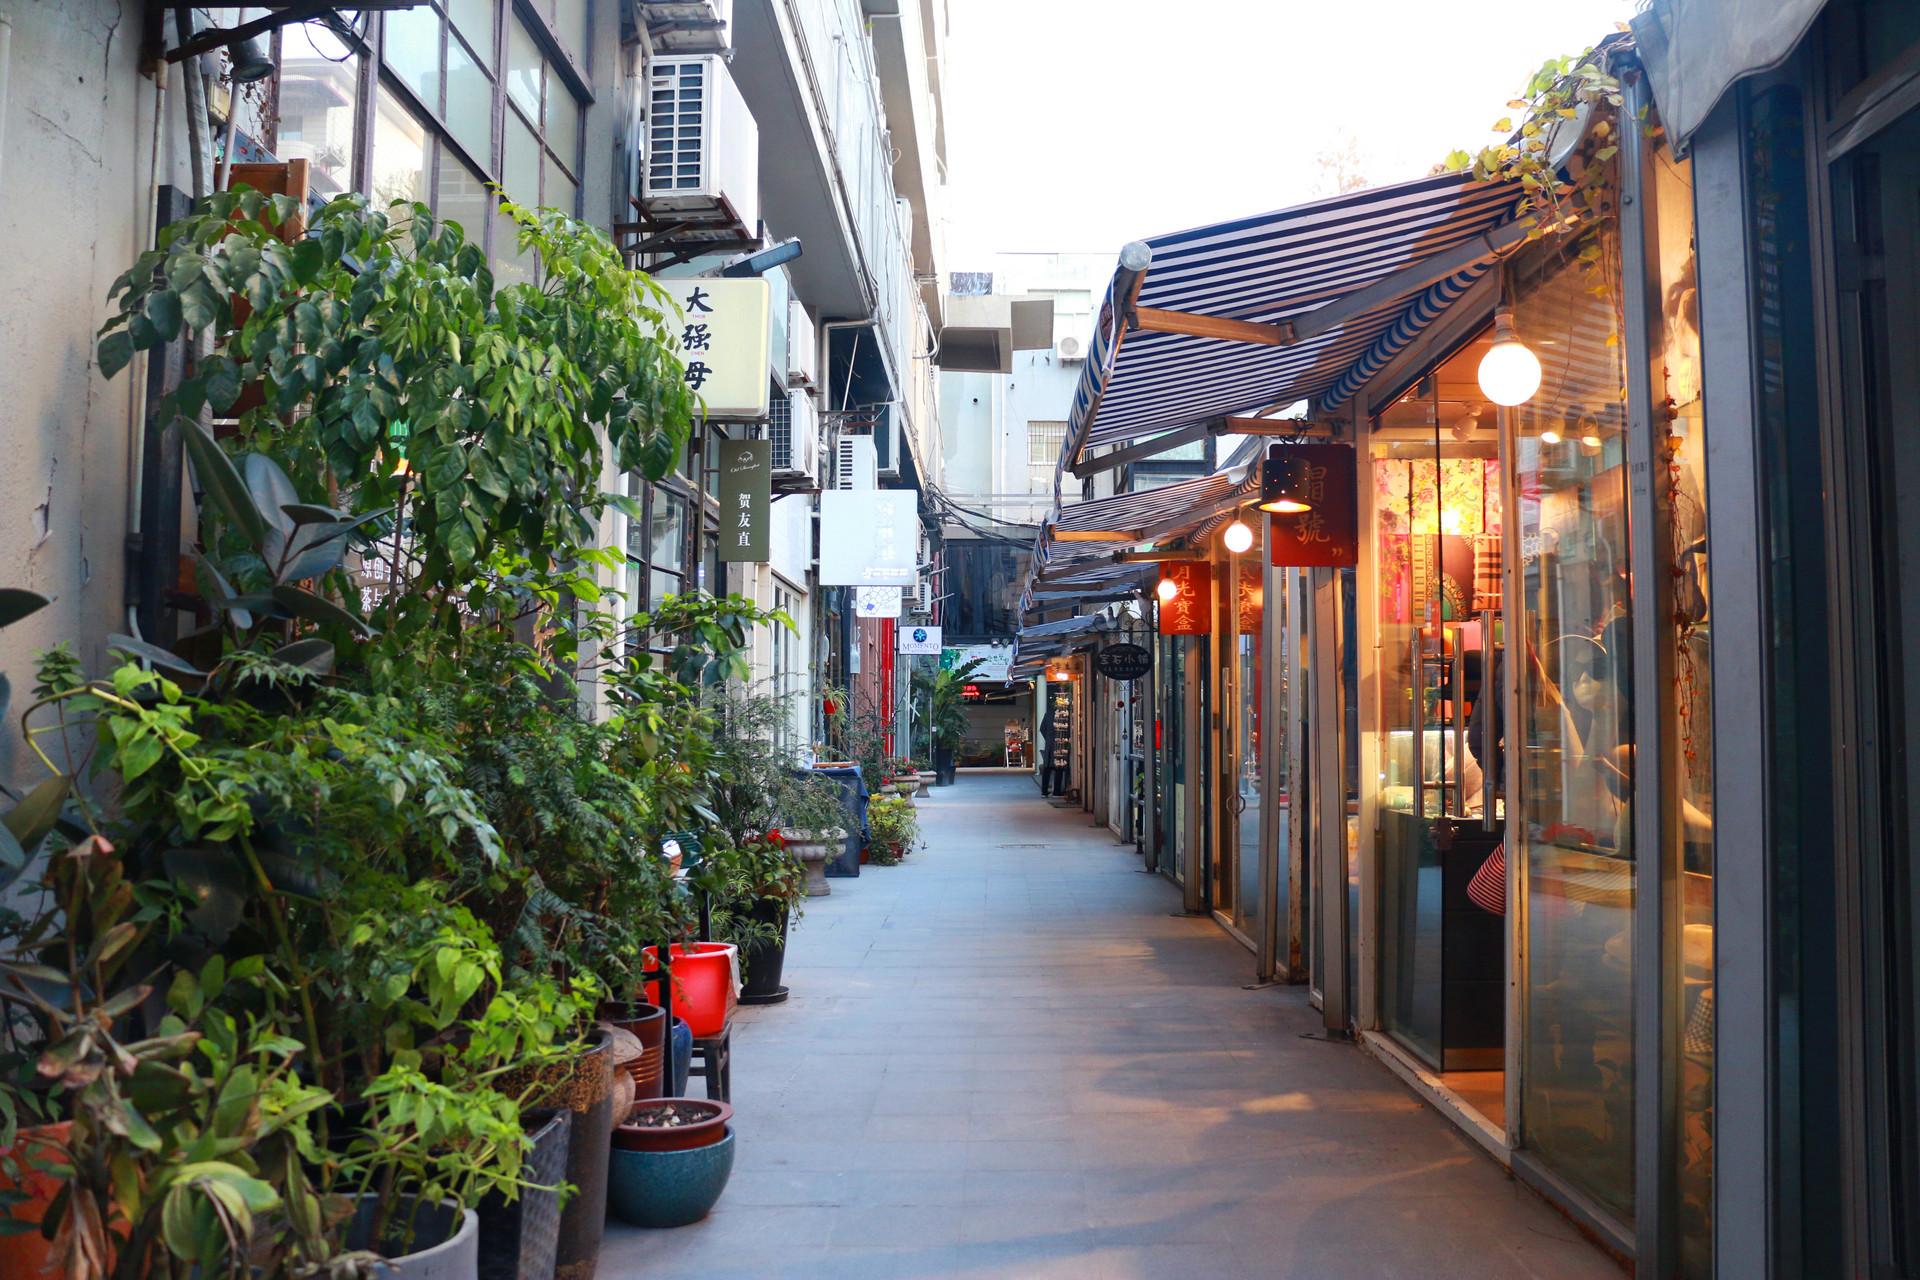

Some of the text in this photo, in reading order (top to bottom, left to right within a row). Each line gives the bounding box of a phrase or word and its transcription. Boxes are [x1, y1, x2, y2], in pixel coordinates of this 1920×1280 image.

[737, 493, 751, 546] 贺友直
[1173, 565, 1196, 631] 月光寶盒
